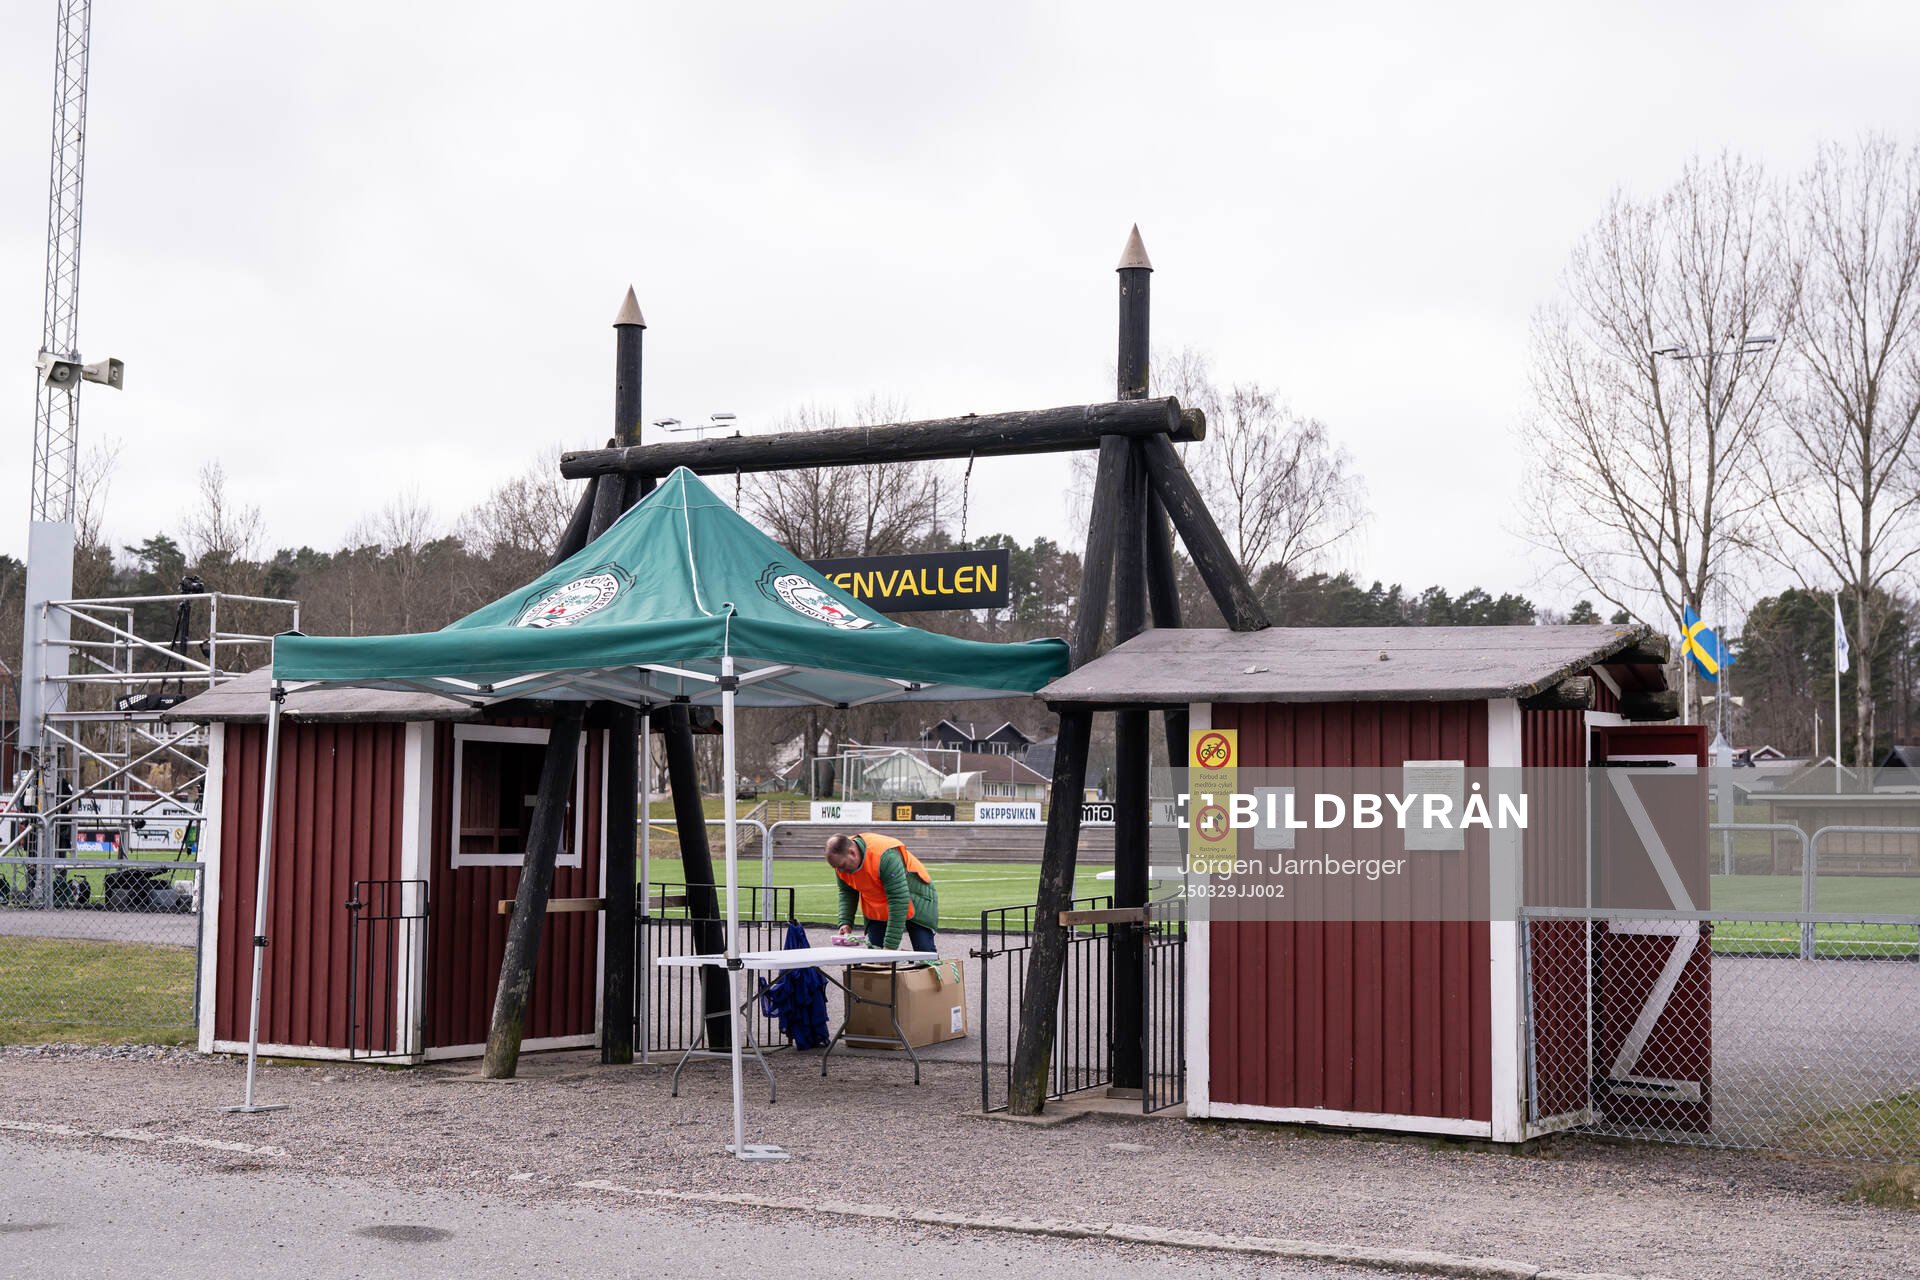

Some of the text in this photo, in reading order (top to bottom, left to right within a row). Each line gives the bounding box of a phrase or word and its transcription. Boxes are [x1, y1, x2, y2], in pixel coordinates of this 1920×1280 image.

[825, 564, 998, 599] ENVALLEN
[821, 806, 841, 819] HVAC
[980, 807, 1036, 820] SKEPPSVIKEN
